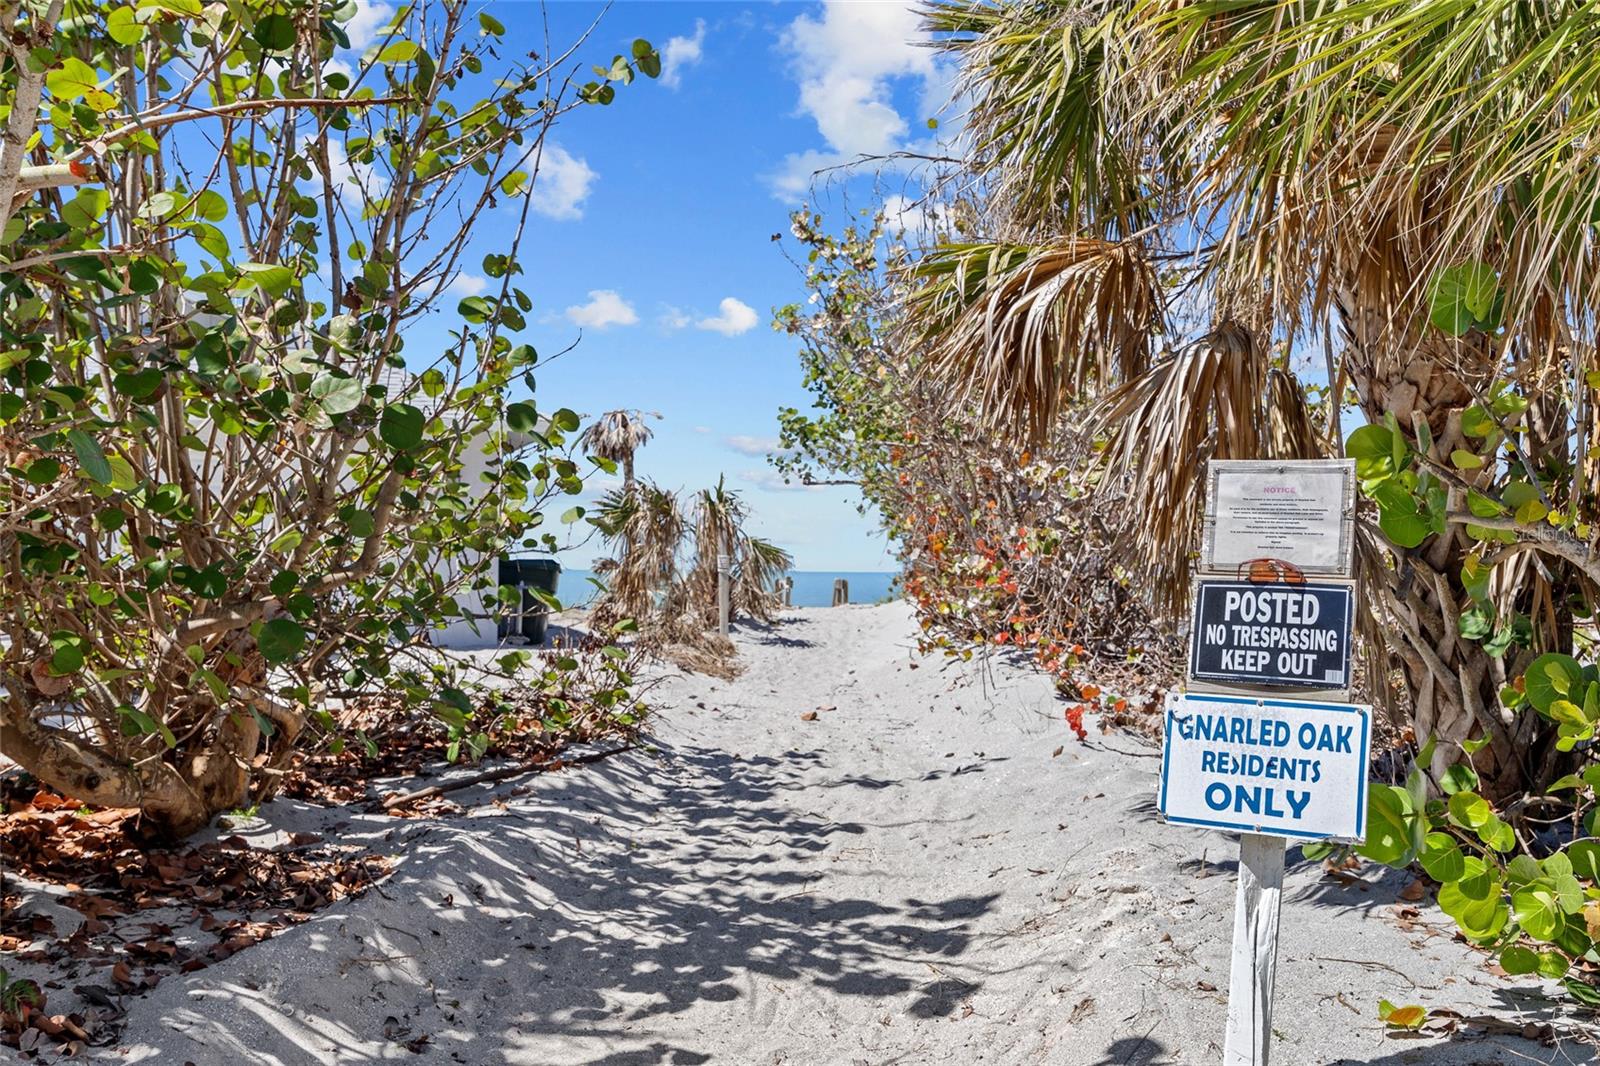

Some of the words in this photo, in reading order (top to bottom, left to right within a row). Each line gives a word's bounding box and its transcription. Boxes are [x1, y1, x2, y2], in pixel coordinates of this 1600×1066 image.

[1263, 486, 1296, 494] NOTICE
[1224, 591, 1320, 625] POSTED
[1205, 624, 1226, 645] NO
[1232, 625, 1337, 652] TRESPASSING
[1221, 649, 1271, 672] KEEP
[1277, 653, 1317, 675] OUT
[1178, 714, 1291, 747] GNARLED
[1298, 722, 1353, 754] OAK
[1205, 782, 1311, 819] ONLY
